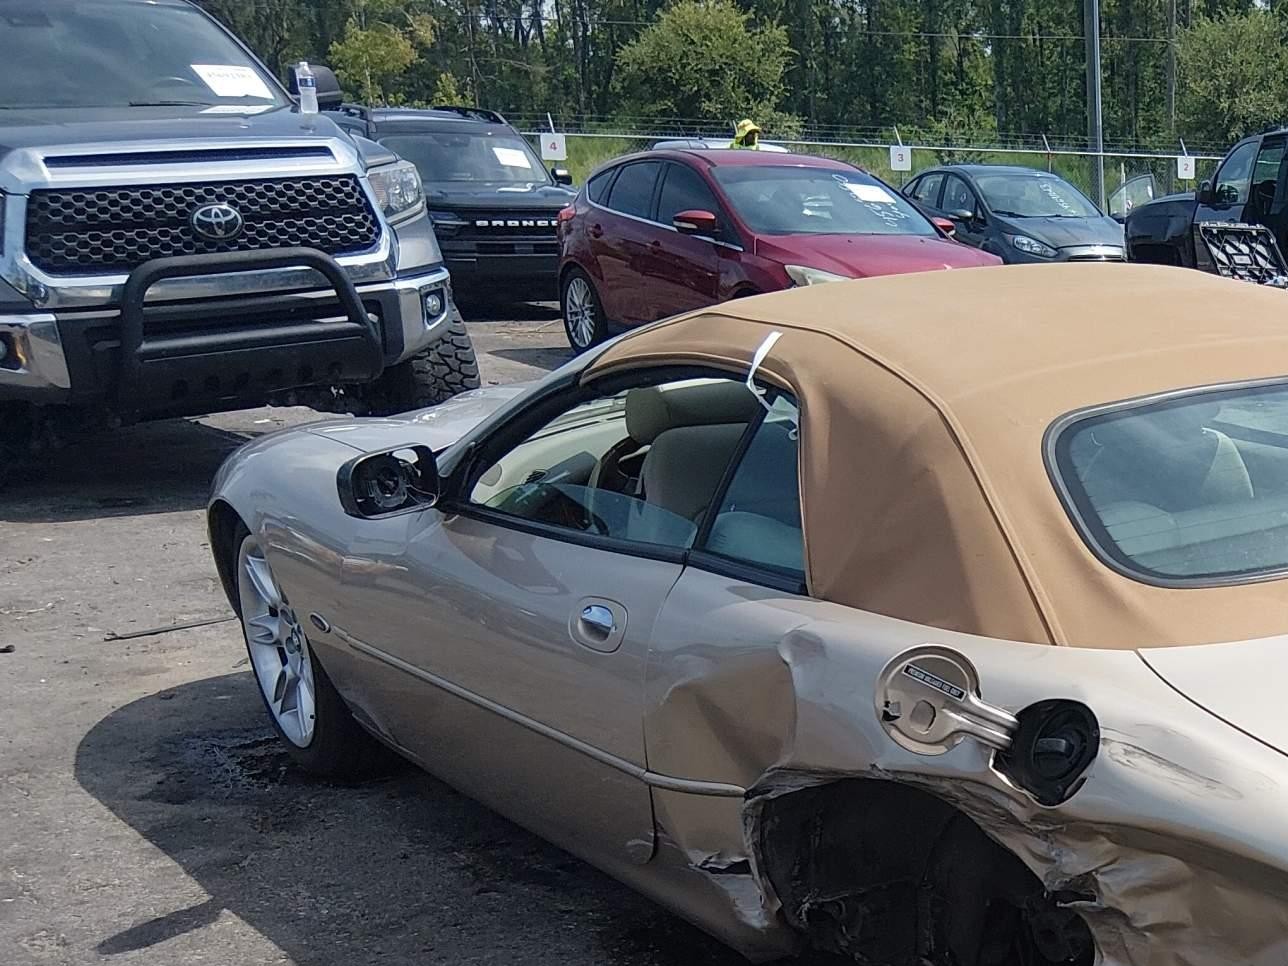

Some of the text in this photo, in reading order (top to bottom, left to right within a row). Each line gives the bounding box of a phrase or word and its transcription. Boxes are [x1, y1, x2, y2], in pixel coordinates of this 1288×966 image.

[549, 142, 558, 151] 4
[897, 153, 904, 162] 3
[1183, 163, 1189, 171] 2
